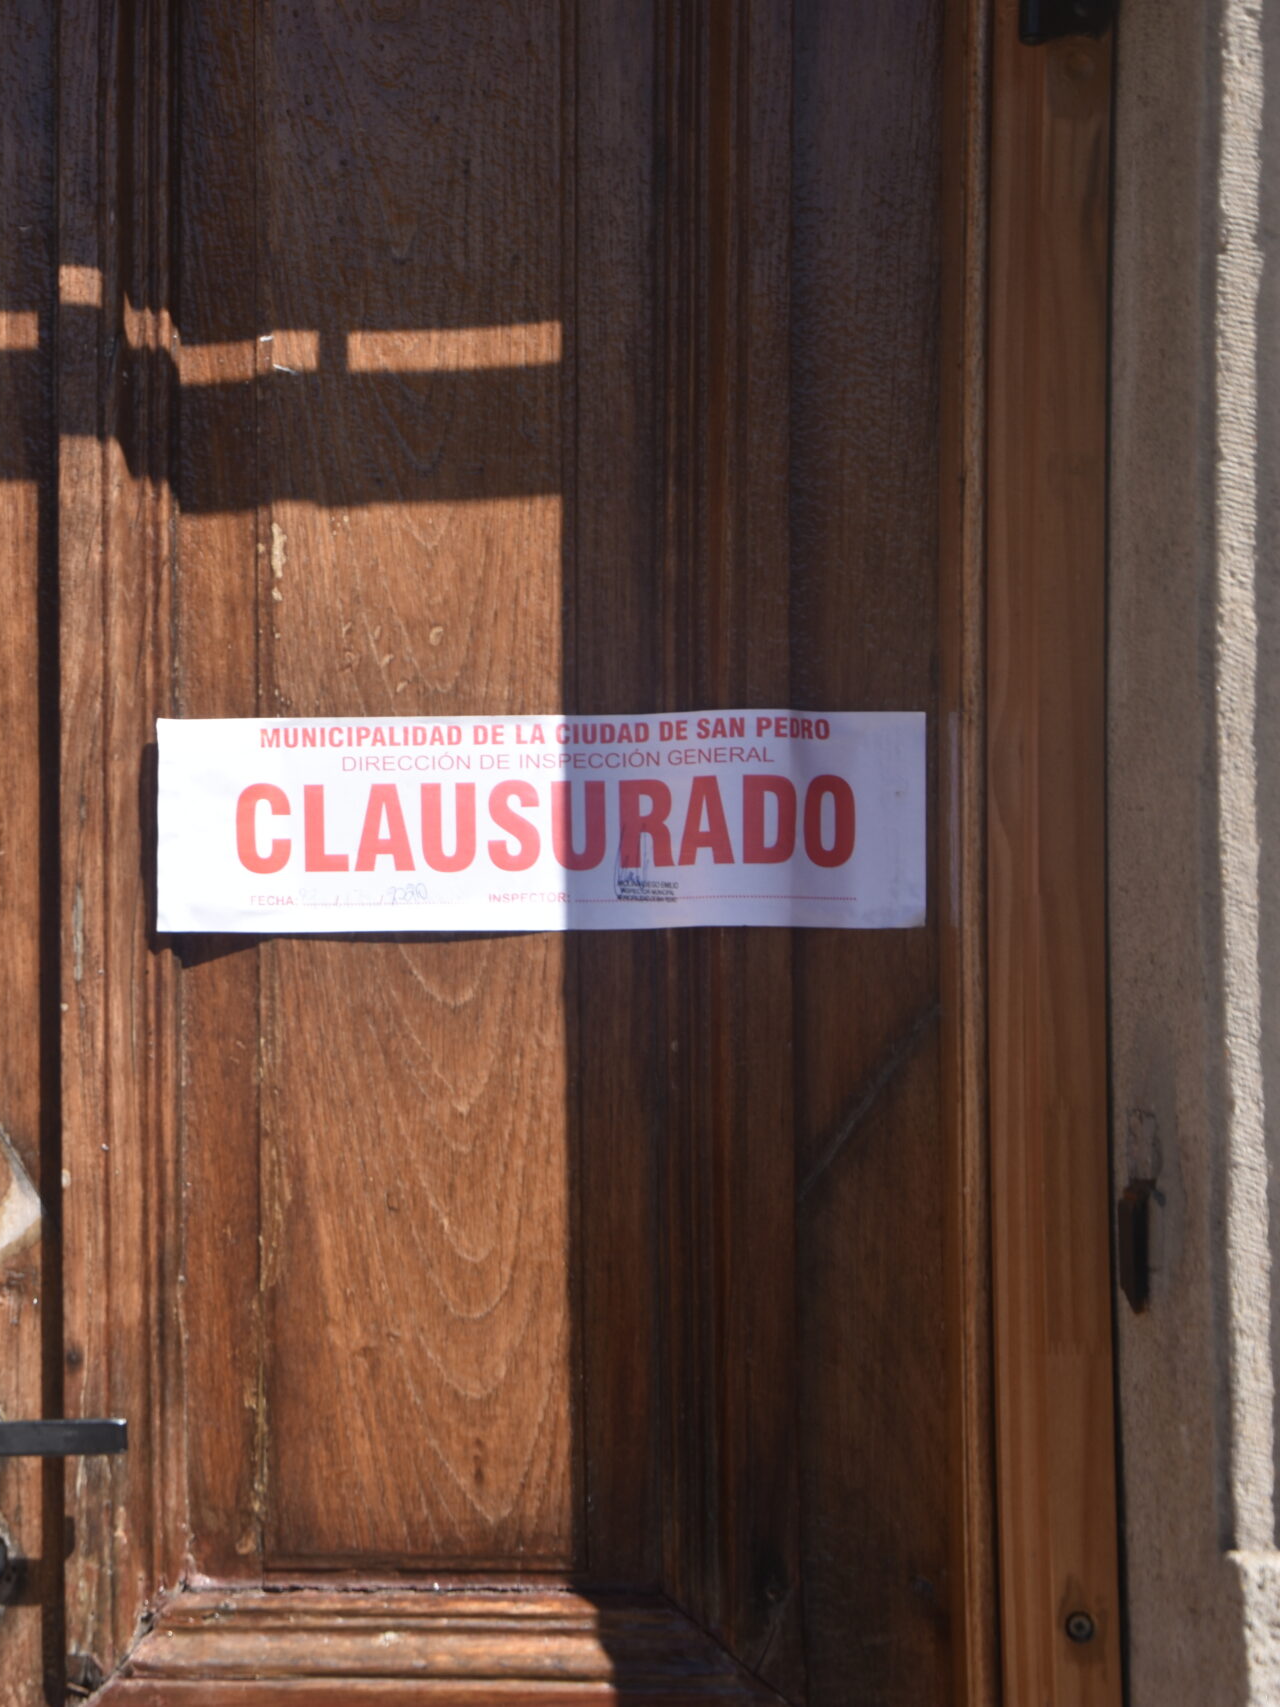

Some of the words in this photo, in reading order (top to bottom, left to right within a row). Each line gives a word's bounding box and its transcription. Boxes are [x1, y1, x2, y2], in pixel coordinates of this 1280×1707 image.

[260, 725, 463, 748] MUNICIPALIDAD
[473, 724, 505, 746] DE
[515, 723, 546, 745] LA
[555, 721, 650, 745] CIUDAD
[659, 719, 688, 742] DE
[696, 717, 746, 740] SAN
[756, 716, 831, 741] PEDRO
[341, 752, 471, 772] DIRECCIÓN
[479, 754, 510, 770] DE
[519, 748, 661, 770] INSPECCIÓN
[667, 746, 775, 767] GENERAL
[235, 774, 856, 875] CLAUSURADO
